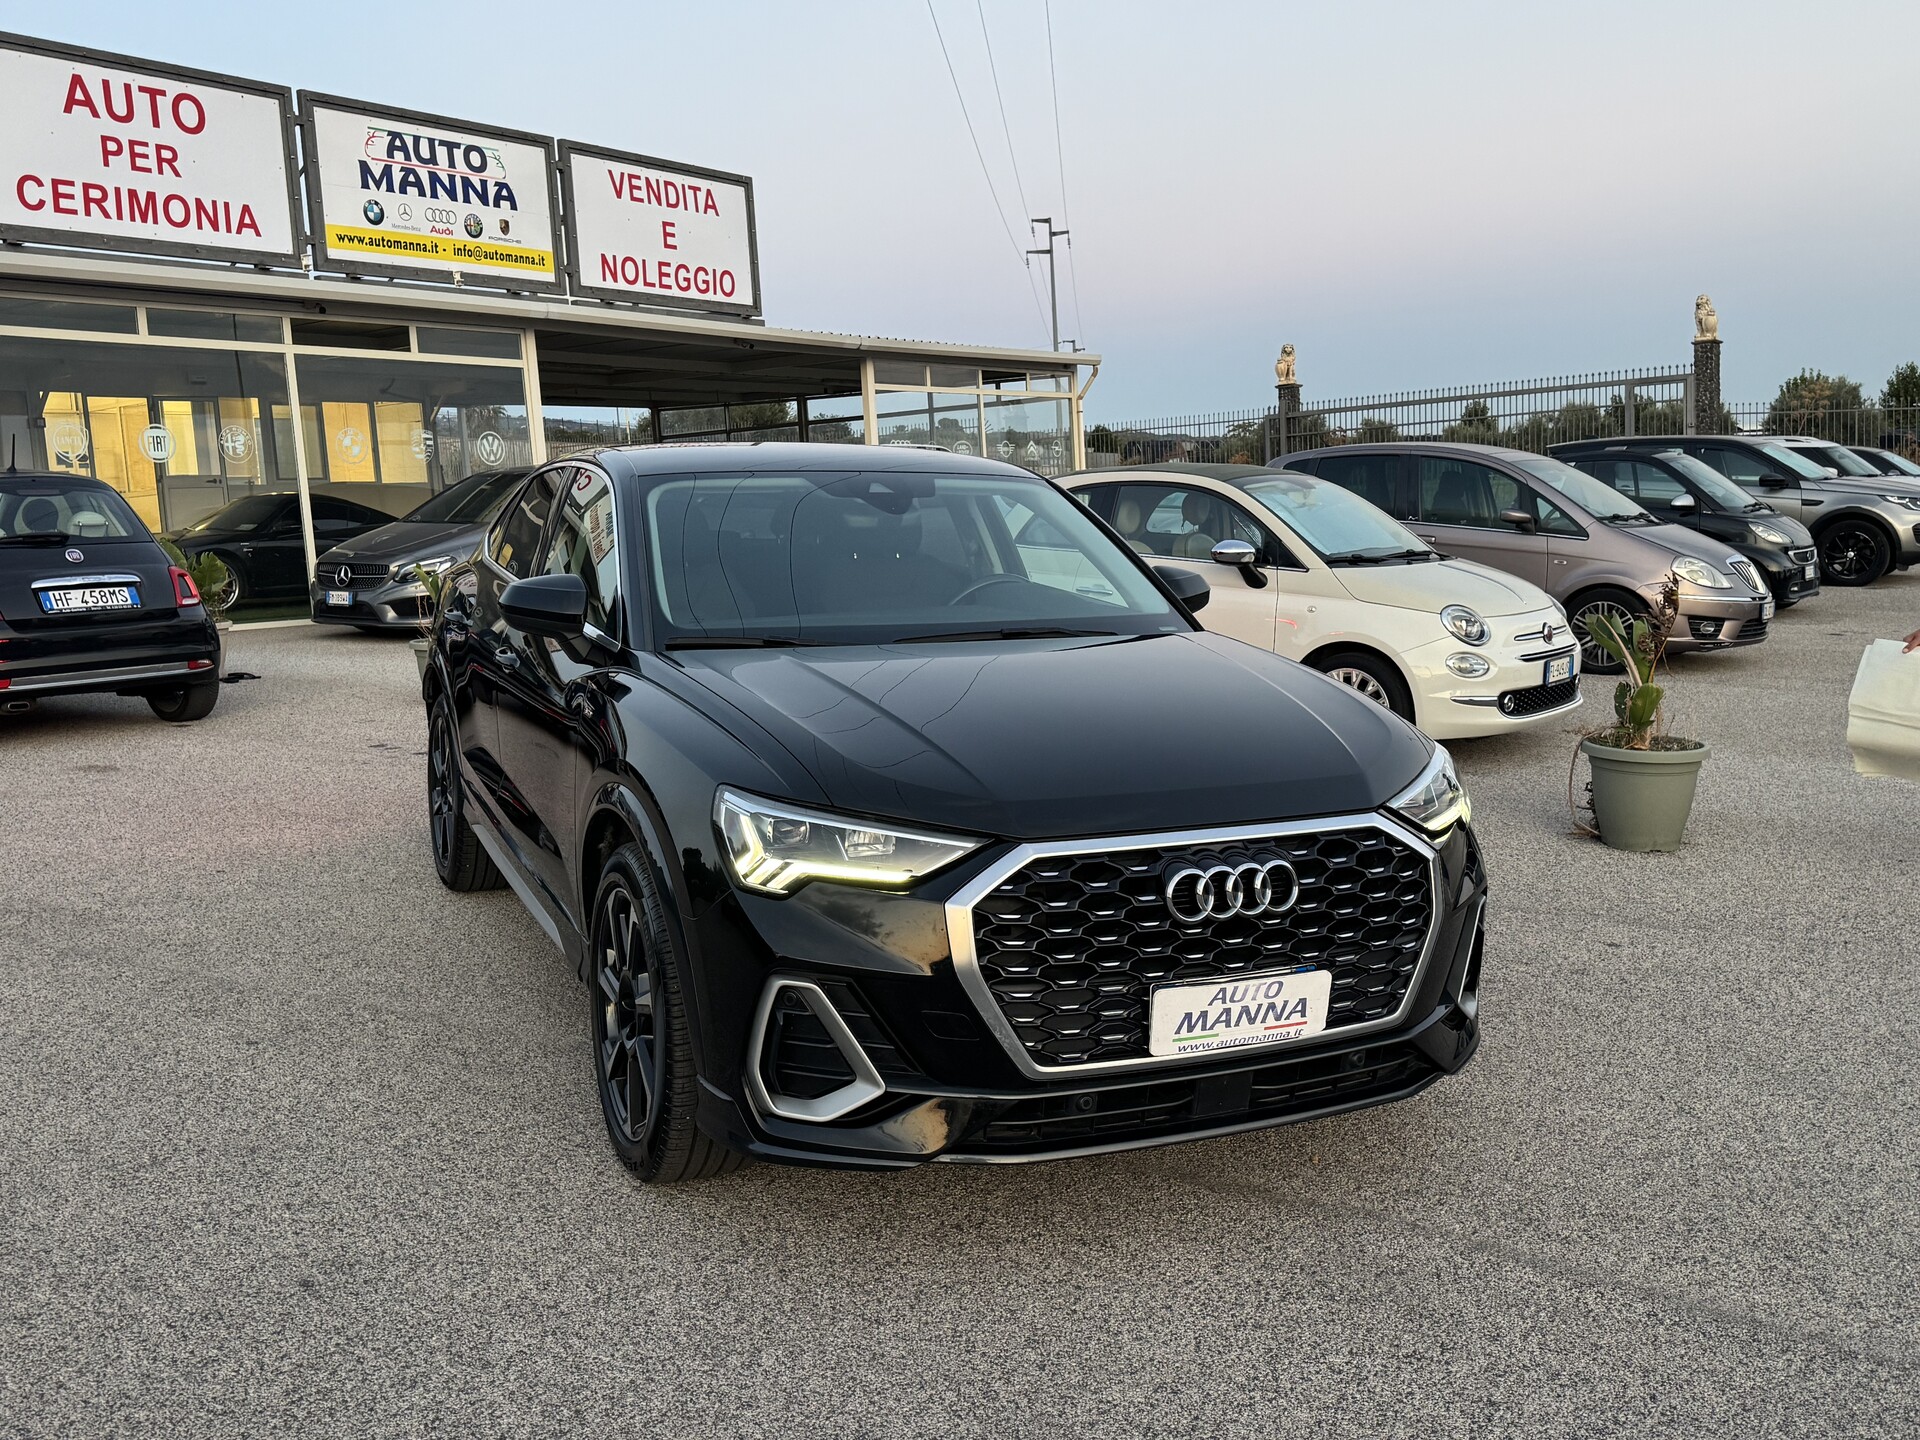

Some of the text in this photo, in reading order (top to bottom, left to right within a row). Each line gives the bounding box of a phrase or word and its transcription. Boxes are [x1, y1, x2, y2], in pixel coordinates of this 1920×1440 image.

[63, 73, 206, 135] AUTO
[100, 134, 182, 178] PER
[386, 131, 488, 174] AUTO
[358, 159, 518, 211] MANNA
[607, 169, 720, 217] VENDITA
[16, 174, 262, 237] CERIMONIA
[430, 225, 454, 236] Audi
[488, 236, 522, 245] PORSCHE
[661, 220, 678, 250] E
[336, 232, 439, 255] www.automanna.it
[453, 243, 546, 267] info@automanna.it
[600, 253, 736, 298] NOLEGGIO
[147, 435, 167, 452] FIAT
[81, 589, 129, 605] 458MS
[1207, 980, 1284, 1006] AUTO
[1174, 997, 1308, 1035] MANNA
[1177, 1028, 1304, 1053] www.automanna.it
